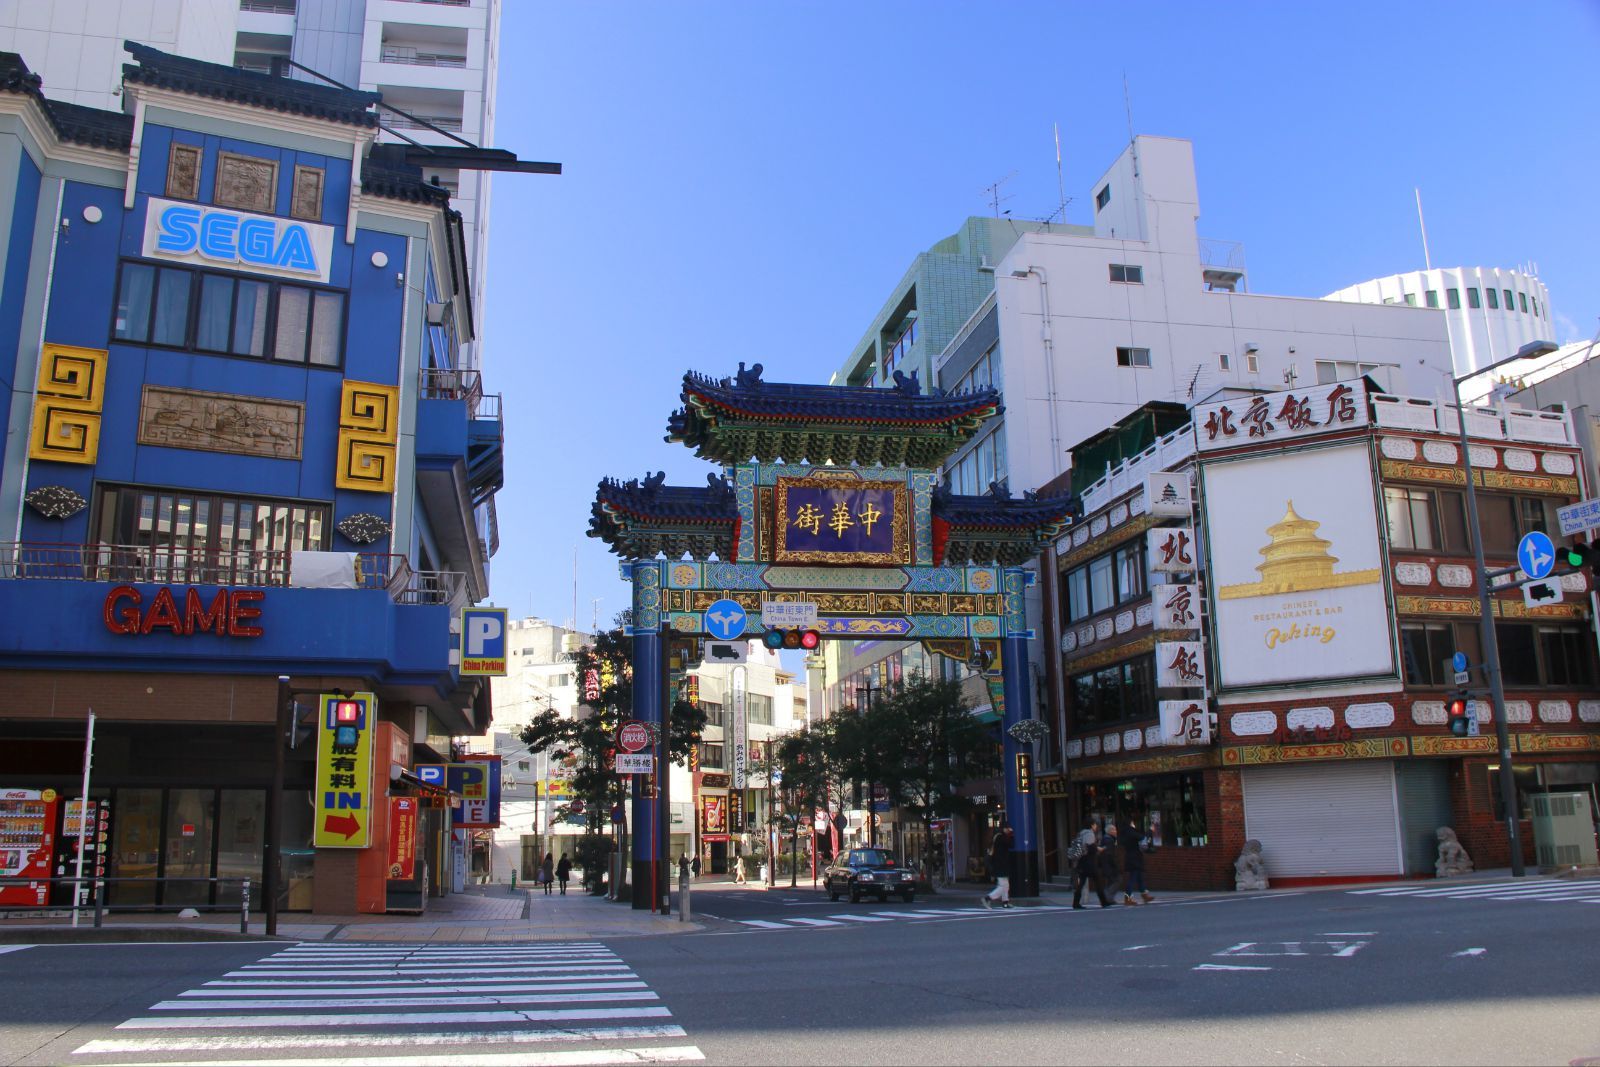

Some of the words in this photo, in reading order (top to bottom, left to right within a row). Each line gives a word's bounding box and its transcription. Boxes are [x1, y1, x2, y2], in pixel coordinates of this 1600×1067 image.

[158, 206, 318, 272] SEGA
[1204, 383, 1357, 440] 北京飯店
[792, 501, 882, 539] 中華街
[1560, 502, 1600, 521] 中華街東
[103, 585, 265, 636] GAME
[766, 605, 804, 616] 中華街東門
[1253, 610, 1313, 622] RESTAURANT
[1315, 607, 1321, 616] &
[1324, 606, 1344, 616] BAR
[1282, 600, 1318, 610] CHINESE
[468, 616, 501, 655] P
[1159, 530, 1204, 738] 北京飯店
[1264, 622, 1336, 650] Peking
[463, 660, 480, 671] China
[482, 660, 505, 672] Parking
[624, 733, 646, 743] 消火栓
[324, 791, 362, 810] IN
